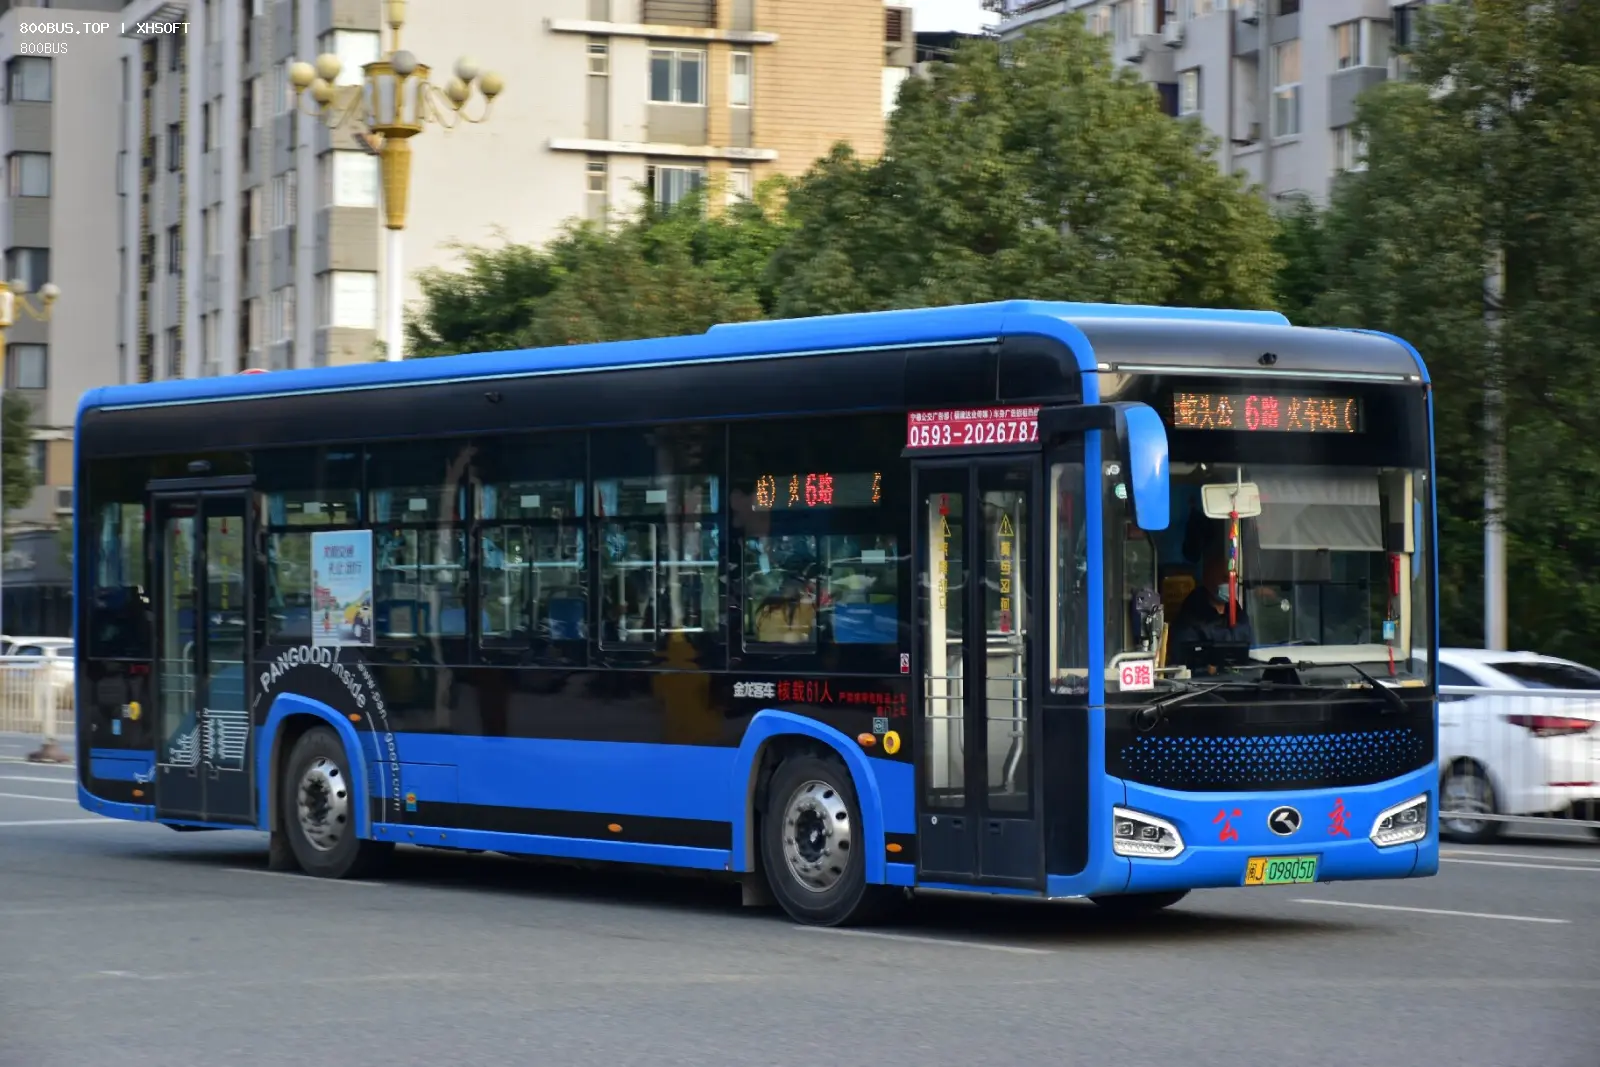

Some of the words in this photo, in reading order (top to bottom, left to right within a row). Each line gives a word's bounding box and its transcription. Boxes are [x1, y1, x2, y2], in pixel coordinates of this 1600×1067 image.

[1245, 395, 1280, 431] 6路
[910, 421, 1039, 447] 0593-2026787
[805, 472, 834, 507] 6路
[260, 645, 331, 693] PANGOOD
[1122, 665, 1150, 685] 6路
[733, 681, 776, 699] 金龙客车
[777, 680, 833, 703] 核载61人
[1212, 808, 1243, 842] 公
[1328, 797, 1351, 838] 交
